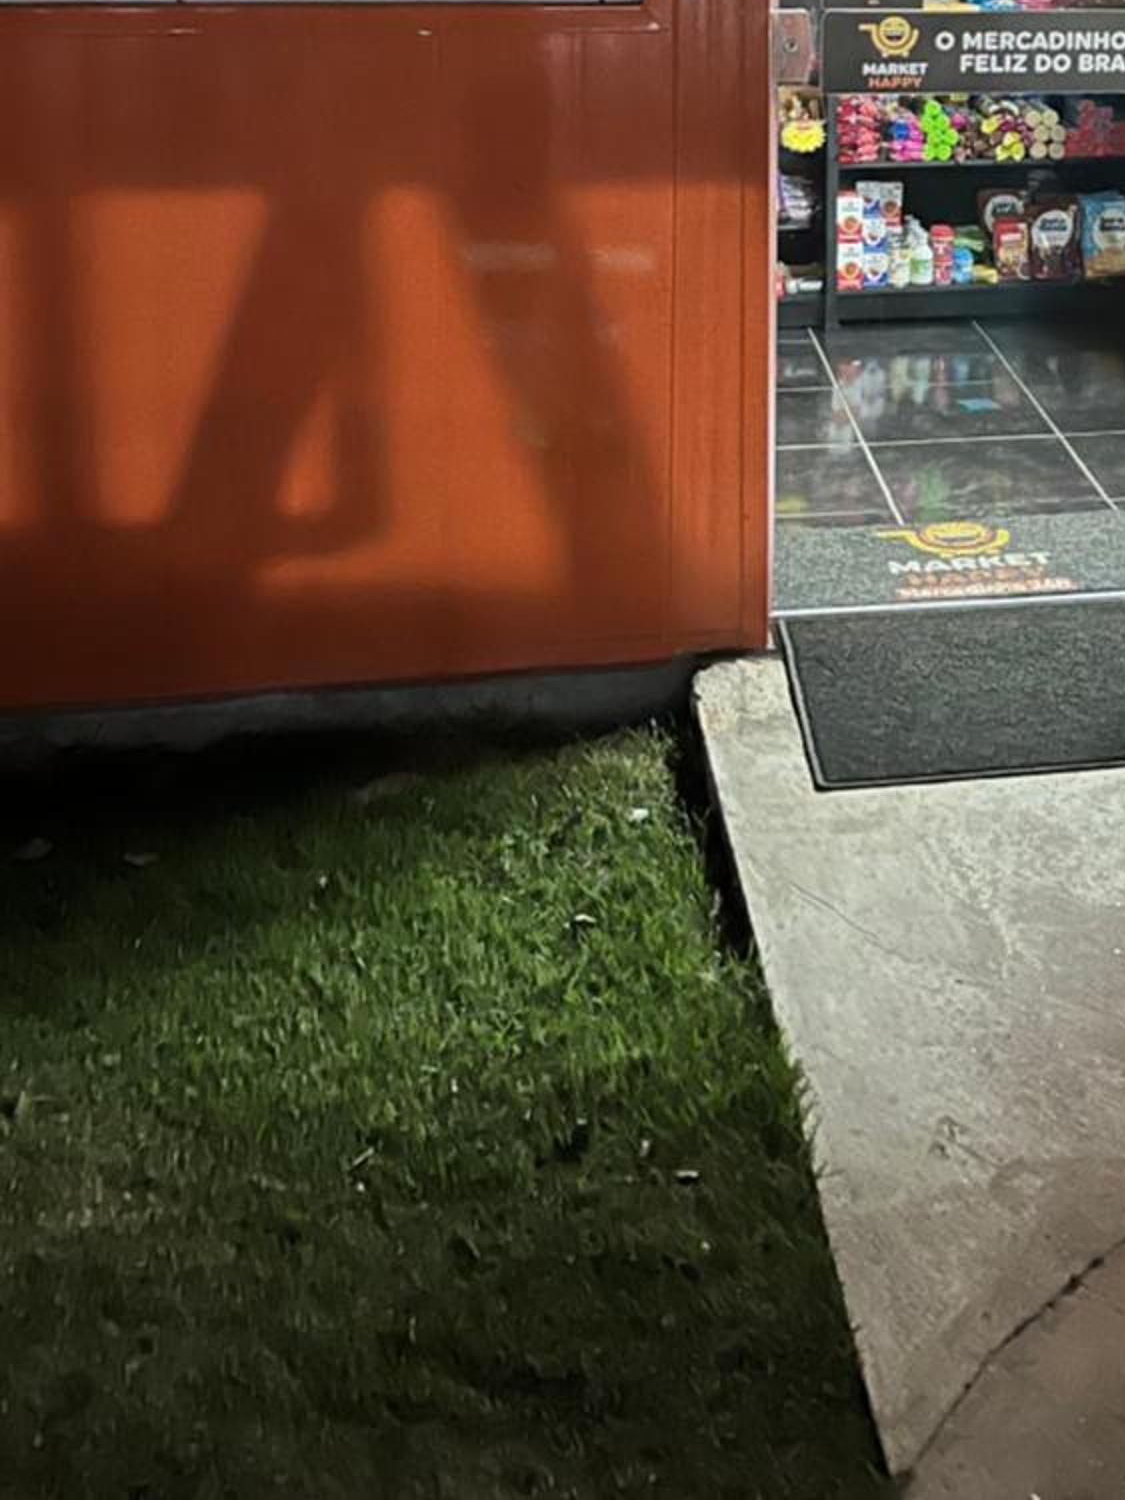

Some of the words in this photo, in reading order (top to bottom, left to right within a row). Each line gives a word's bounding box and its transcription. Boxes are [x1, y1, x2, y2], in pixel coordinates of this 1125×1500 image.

[934, 31, 955, 51] O
[862, 62, 928, 76] MARKET
[960, 53, 1027, 73] FELIZ
[1034, 53, 1071, 73] DO
[867, 77, 922, 89] HAPPY
[888, 551, 1049, 574] MARKET
